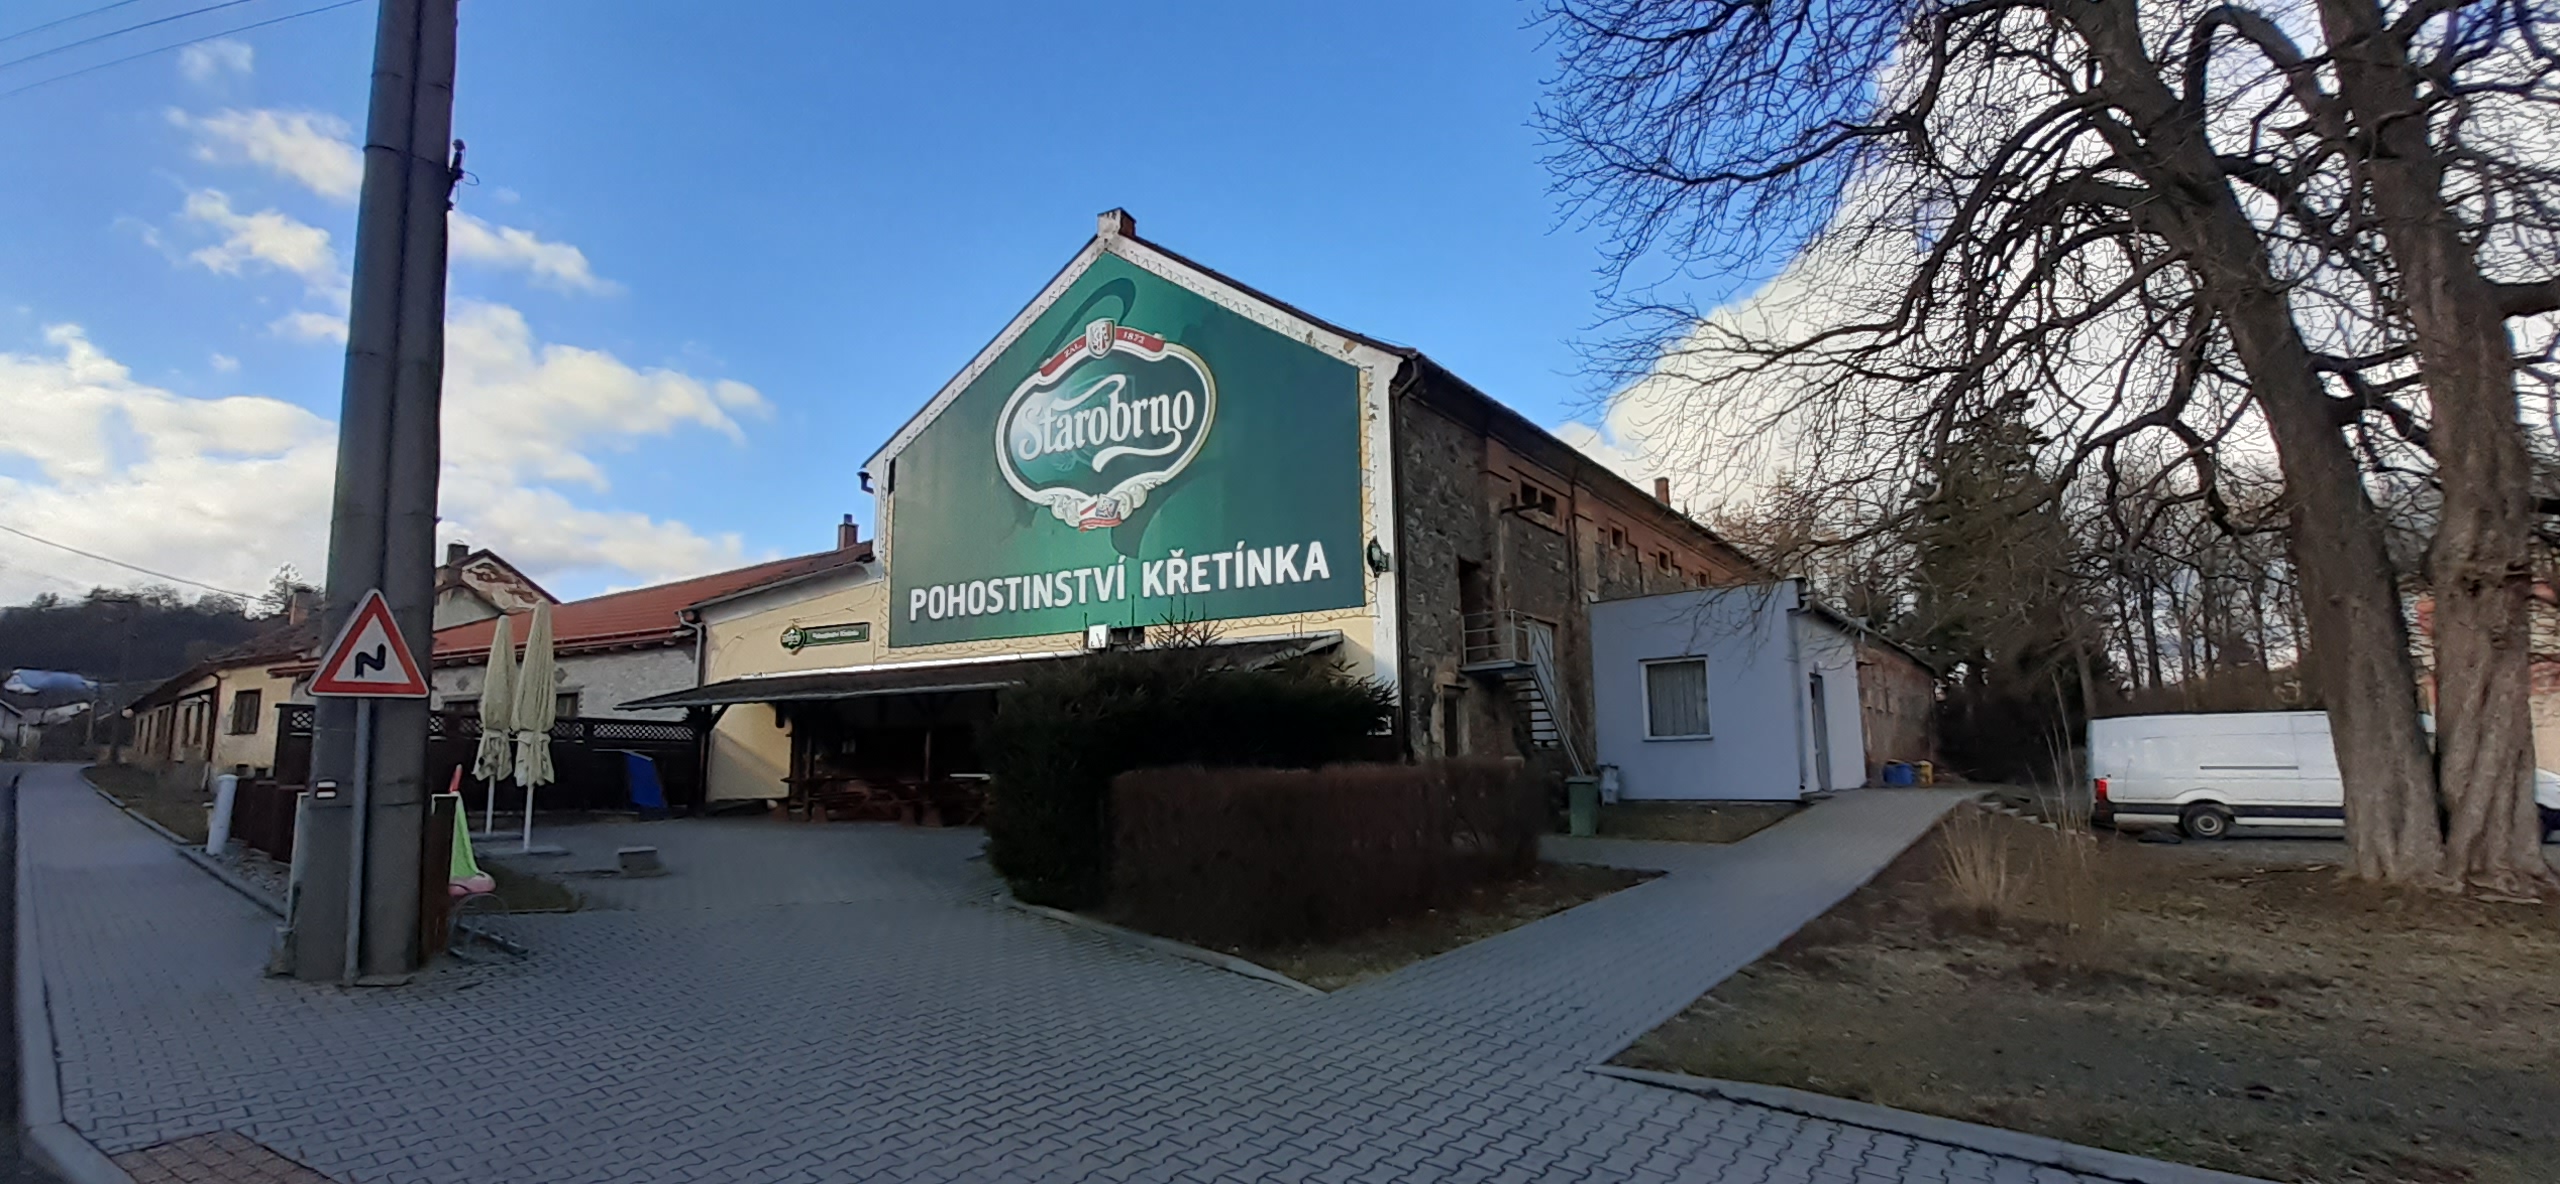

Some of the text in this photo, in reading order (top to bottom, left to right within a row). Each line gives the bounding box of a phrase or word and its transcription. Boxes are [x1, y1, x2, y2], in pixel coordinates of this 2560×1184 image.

[1123, 331, 1146, 344] 1872
[1018, 374, 1195, 472] Starobrno
[909, 540, 1330, 622] POHOSTINSTVÍ KŘETÍNKA
